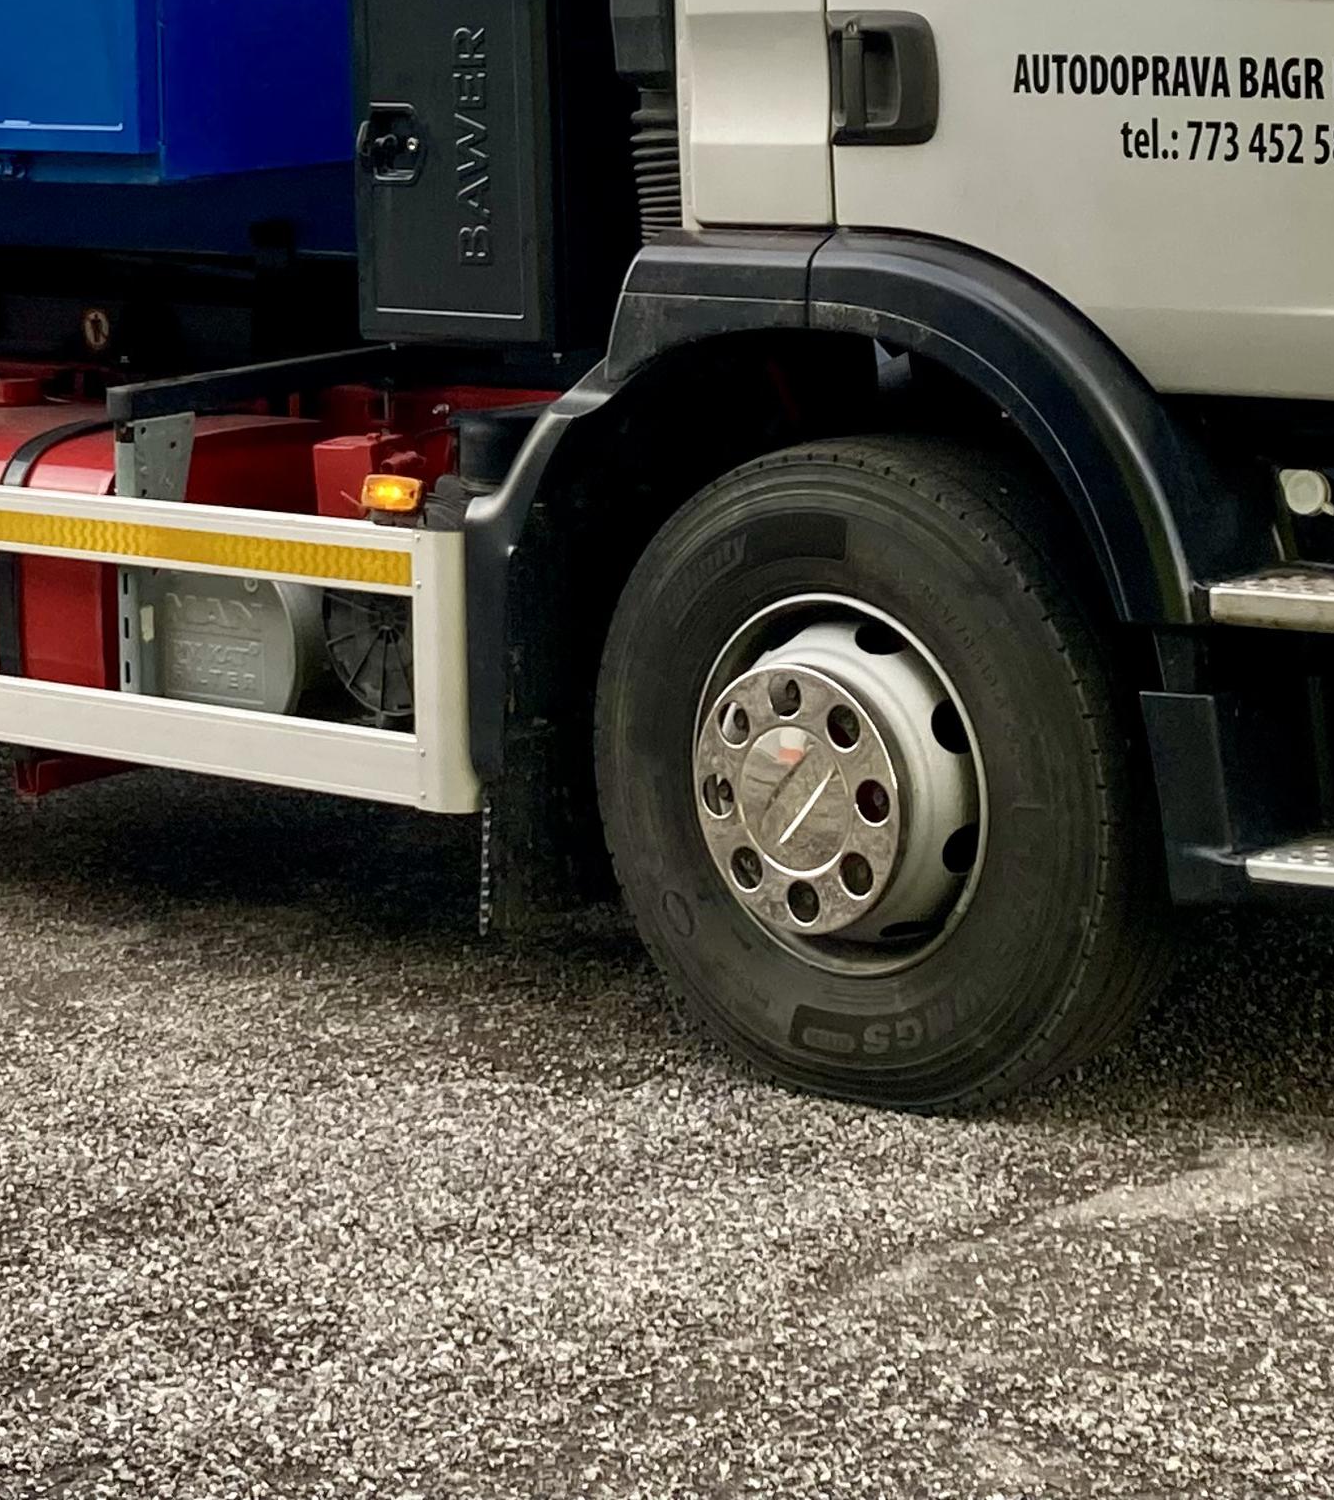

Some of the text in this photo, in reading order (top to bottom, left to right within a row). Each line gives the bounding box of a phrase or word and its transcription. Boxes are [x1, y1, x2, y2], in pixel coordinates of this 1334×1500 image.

[1013, 53, 1231, 98] AUTODOPRAVA
[1239, 56, 1325, 100] BAGR
[453, 26, 493, 267] BAWER
[1120, 117, 1179, 161] tel.:
[1186, 120, 1240, 162] 773
[1248, 122, 1304, 165] 452
